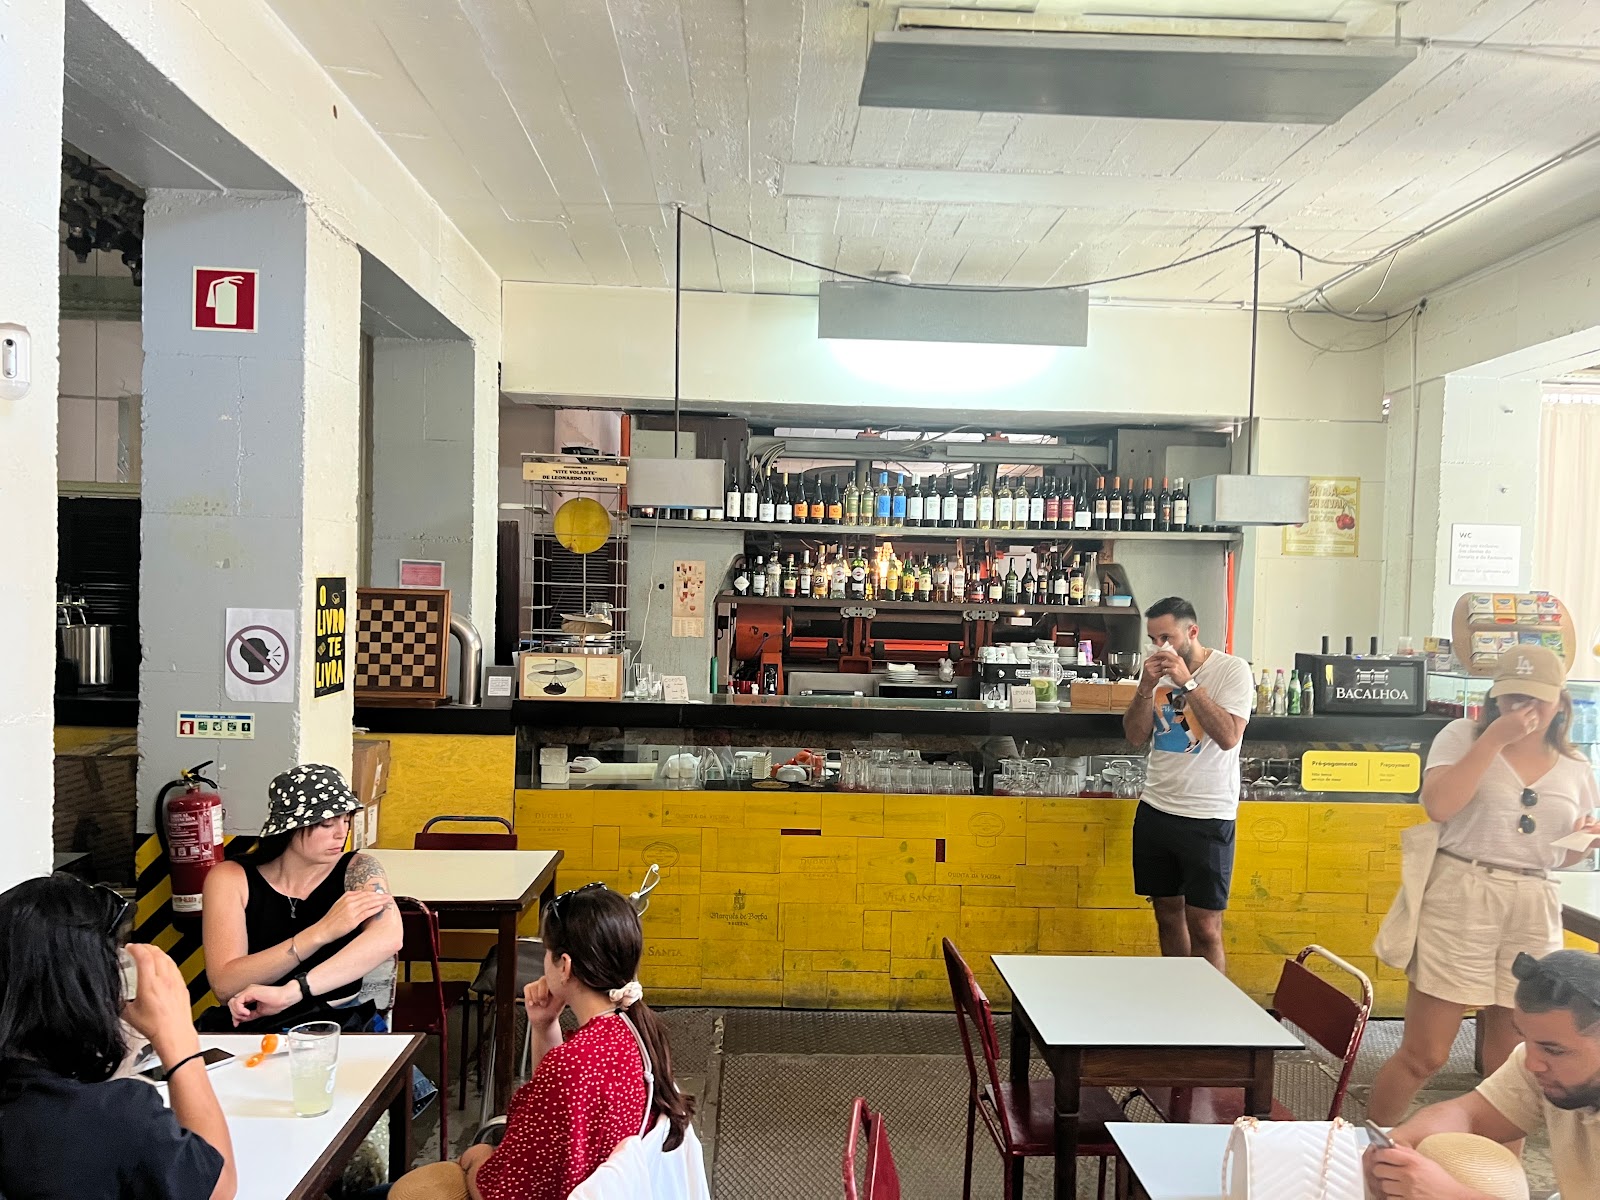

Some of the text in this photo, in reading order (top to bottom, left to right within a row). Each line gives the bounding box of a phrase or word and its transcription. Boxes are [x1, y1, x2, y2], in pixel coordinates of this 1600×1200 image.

[319, 585, 327, 607] O
[317, 607, 345, 637] LIVRO
[327, 636, 342, 658] TE
[315, 659, 344, 689] LIVRA
[1515, 655, 1534, 675] LA
[739, 912, 747, 920] de
